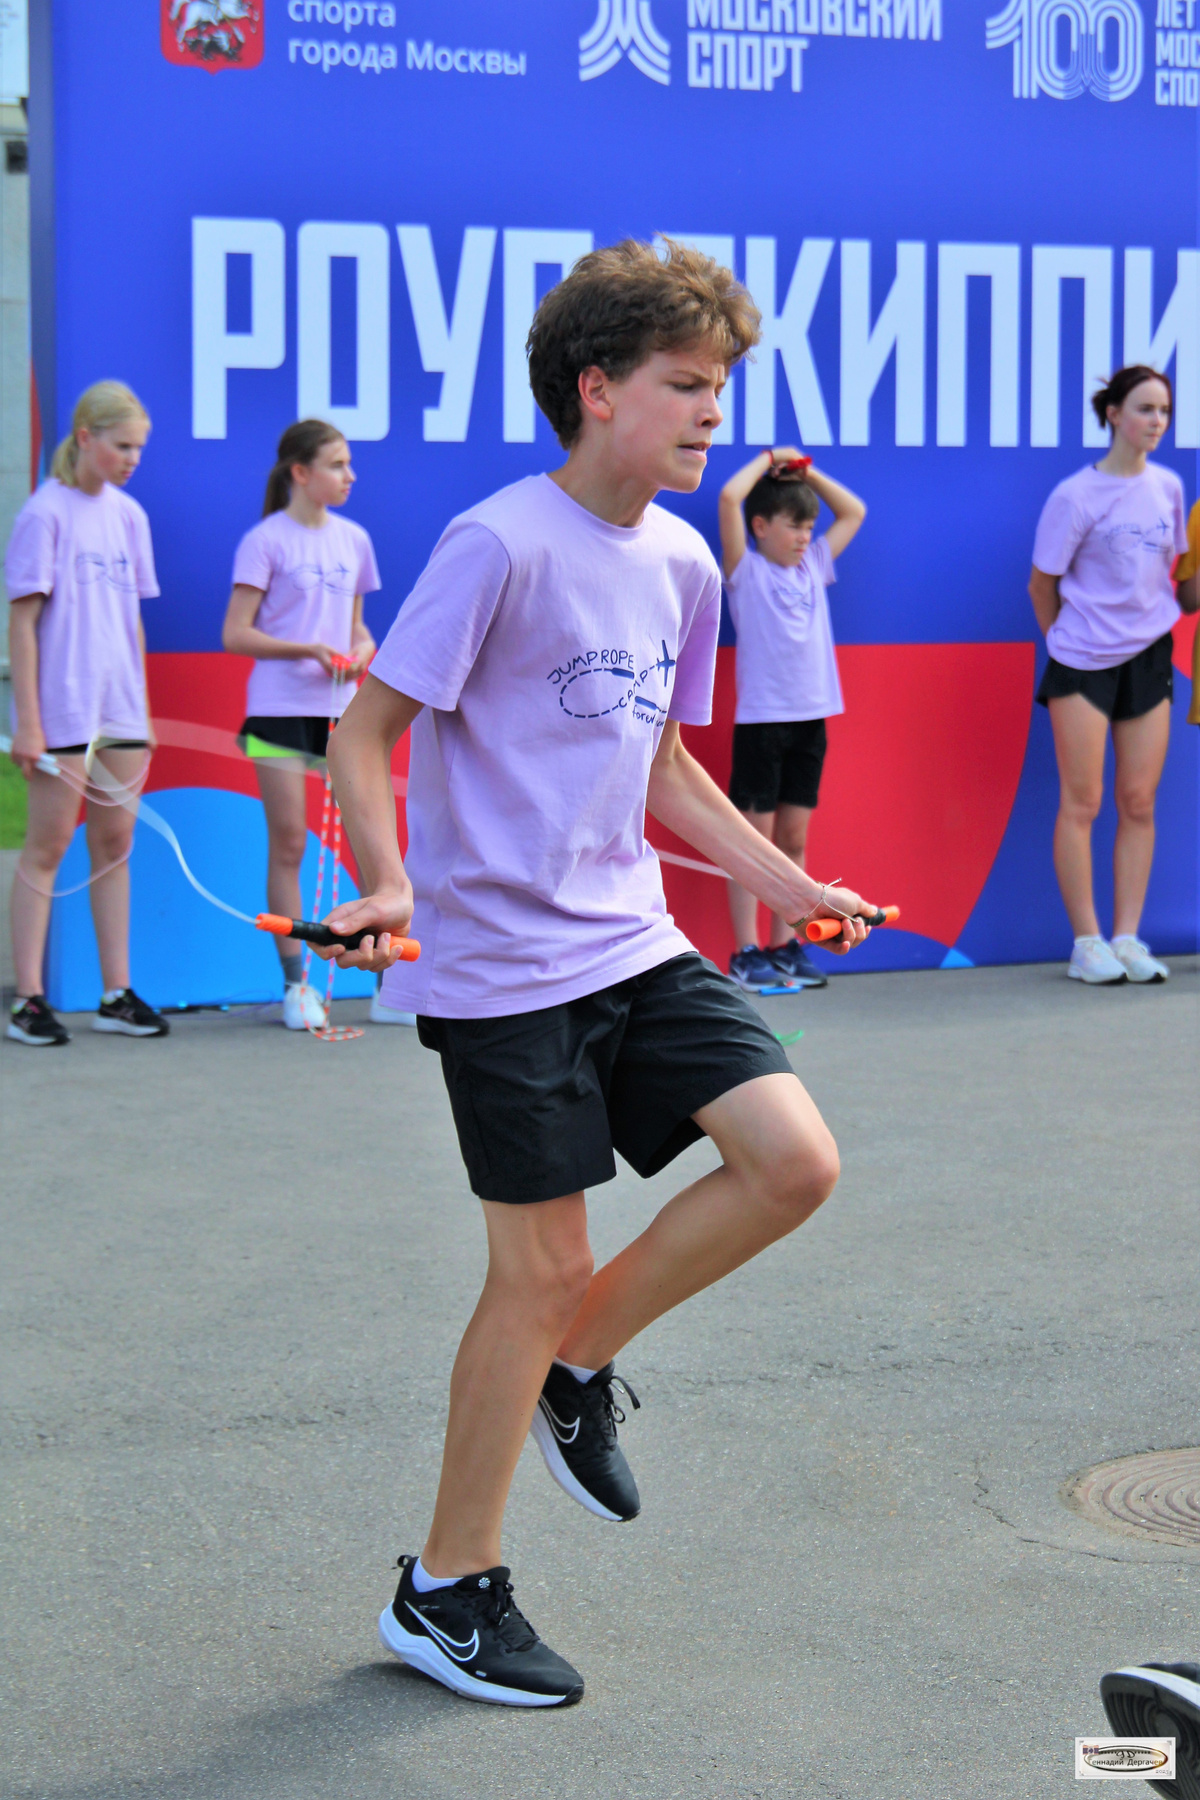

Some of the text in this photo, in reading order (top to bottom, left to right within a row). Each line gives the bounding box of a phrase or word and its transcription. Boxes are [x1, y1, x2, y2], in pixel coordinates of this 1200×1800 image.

[288, 0, 396, 33] спорта
[288, 39, 527, 76] города Москвы
[687, 32, 809, 93] СПОРТ
